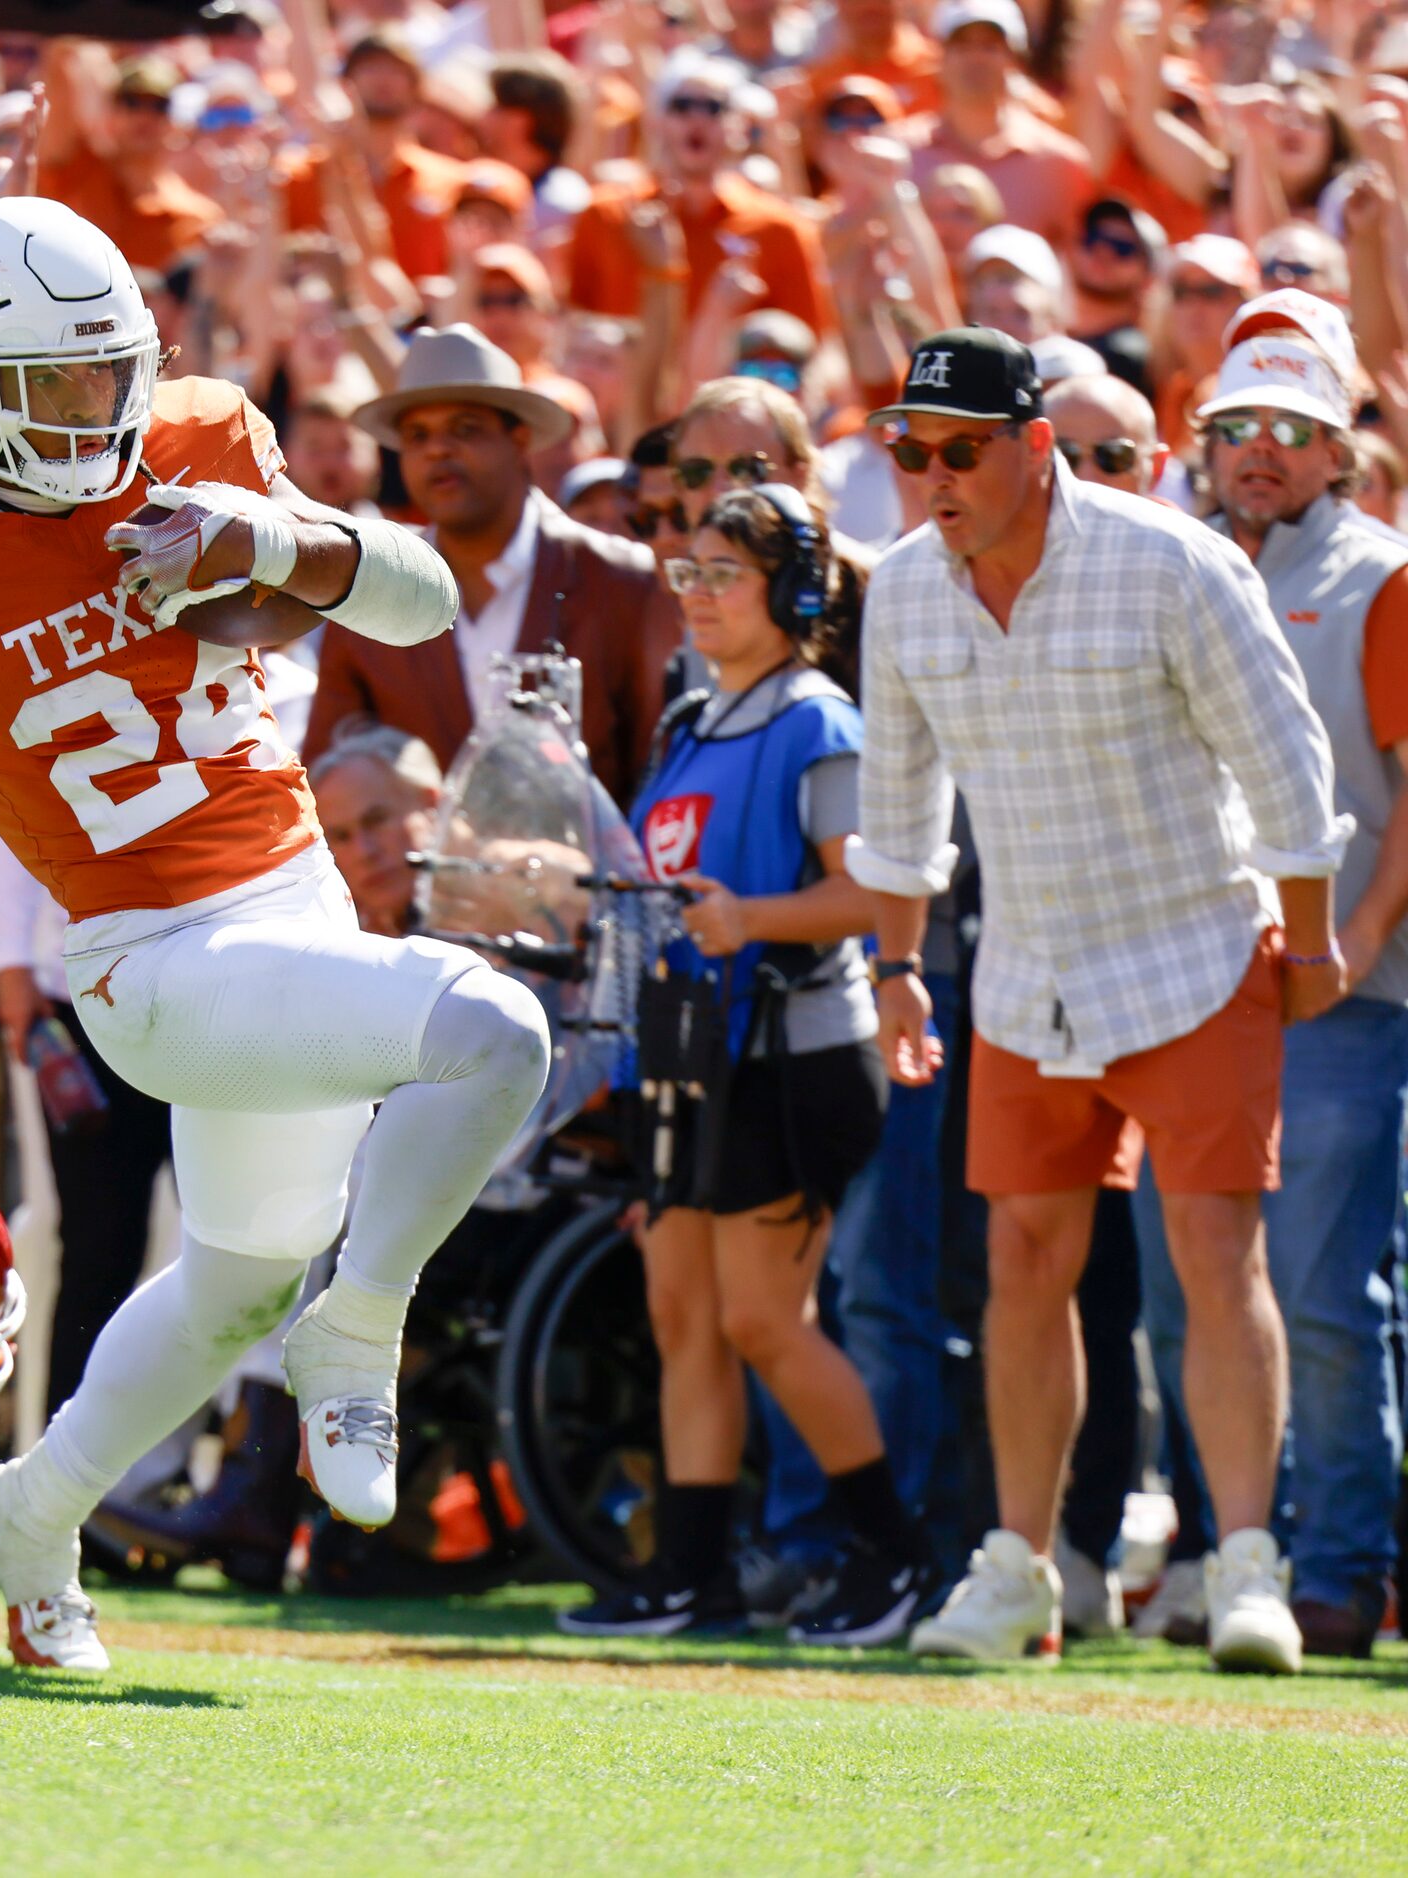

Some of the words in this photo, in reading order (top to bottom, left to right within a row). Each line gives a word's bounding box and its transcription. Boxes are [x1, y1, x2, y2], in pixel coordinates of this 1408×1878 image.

[907, 351, 954, 388] LA
[0, 585, 176, 685] TEX
[9, 639, 282, 855] 24
